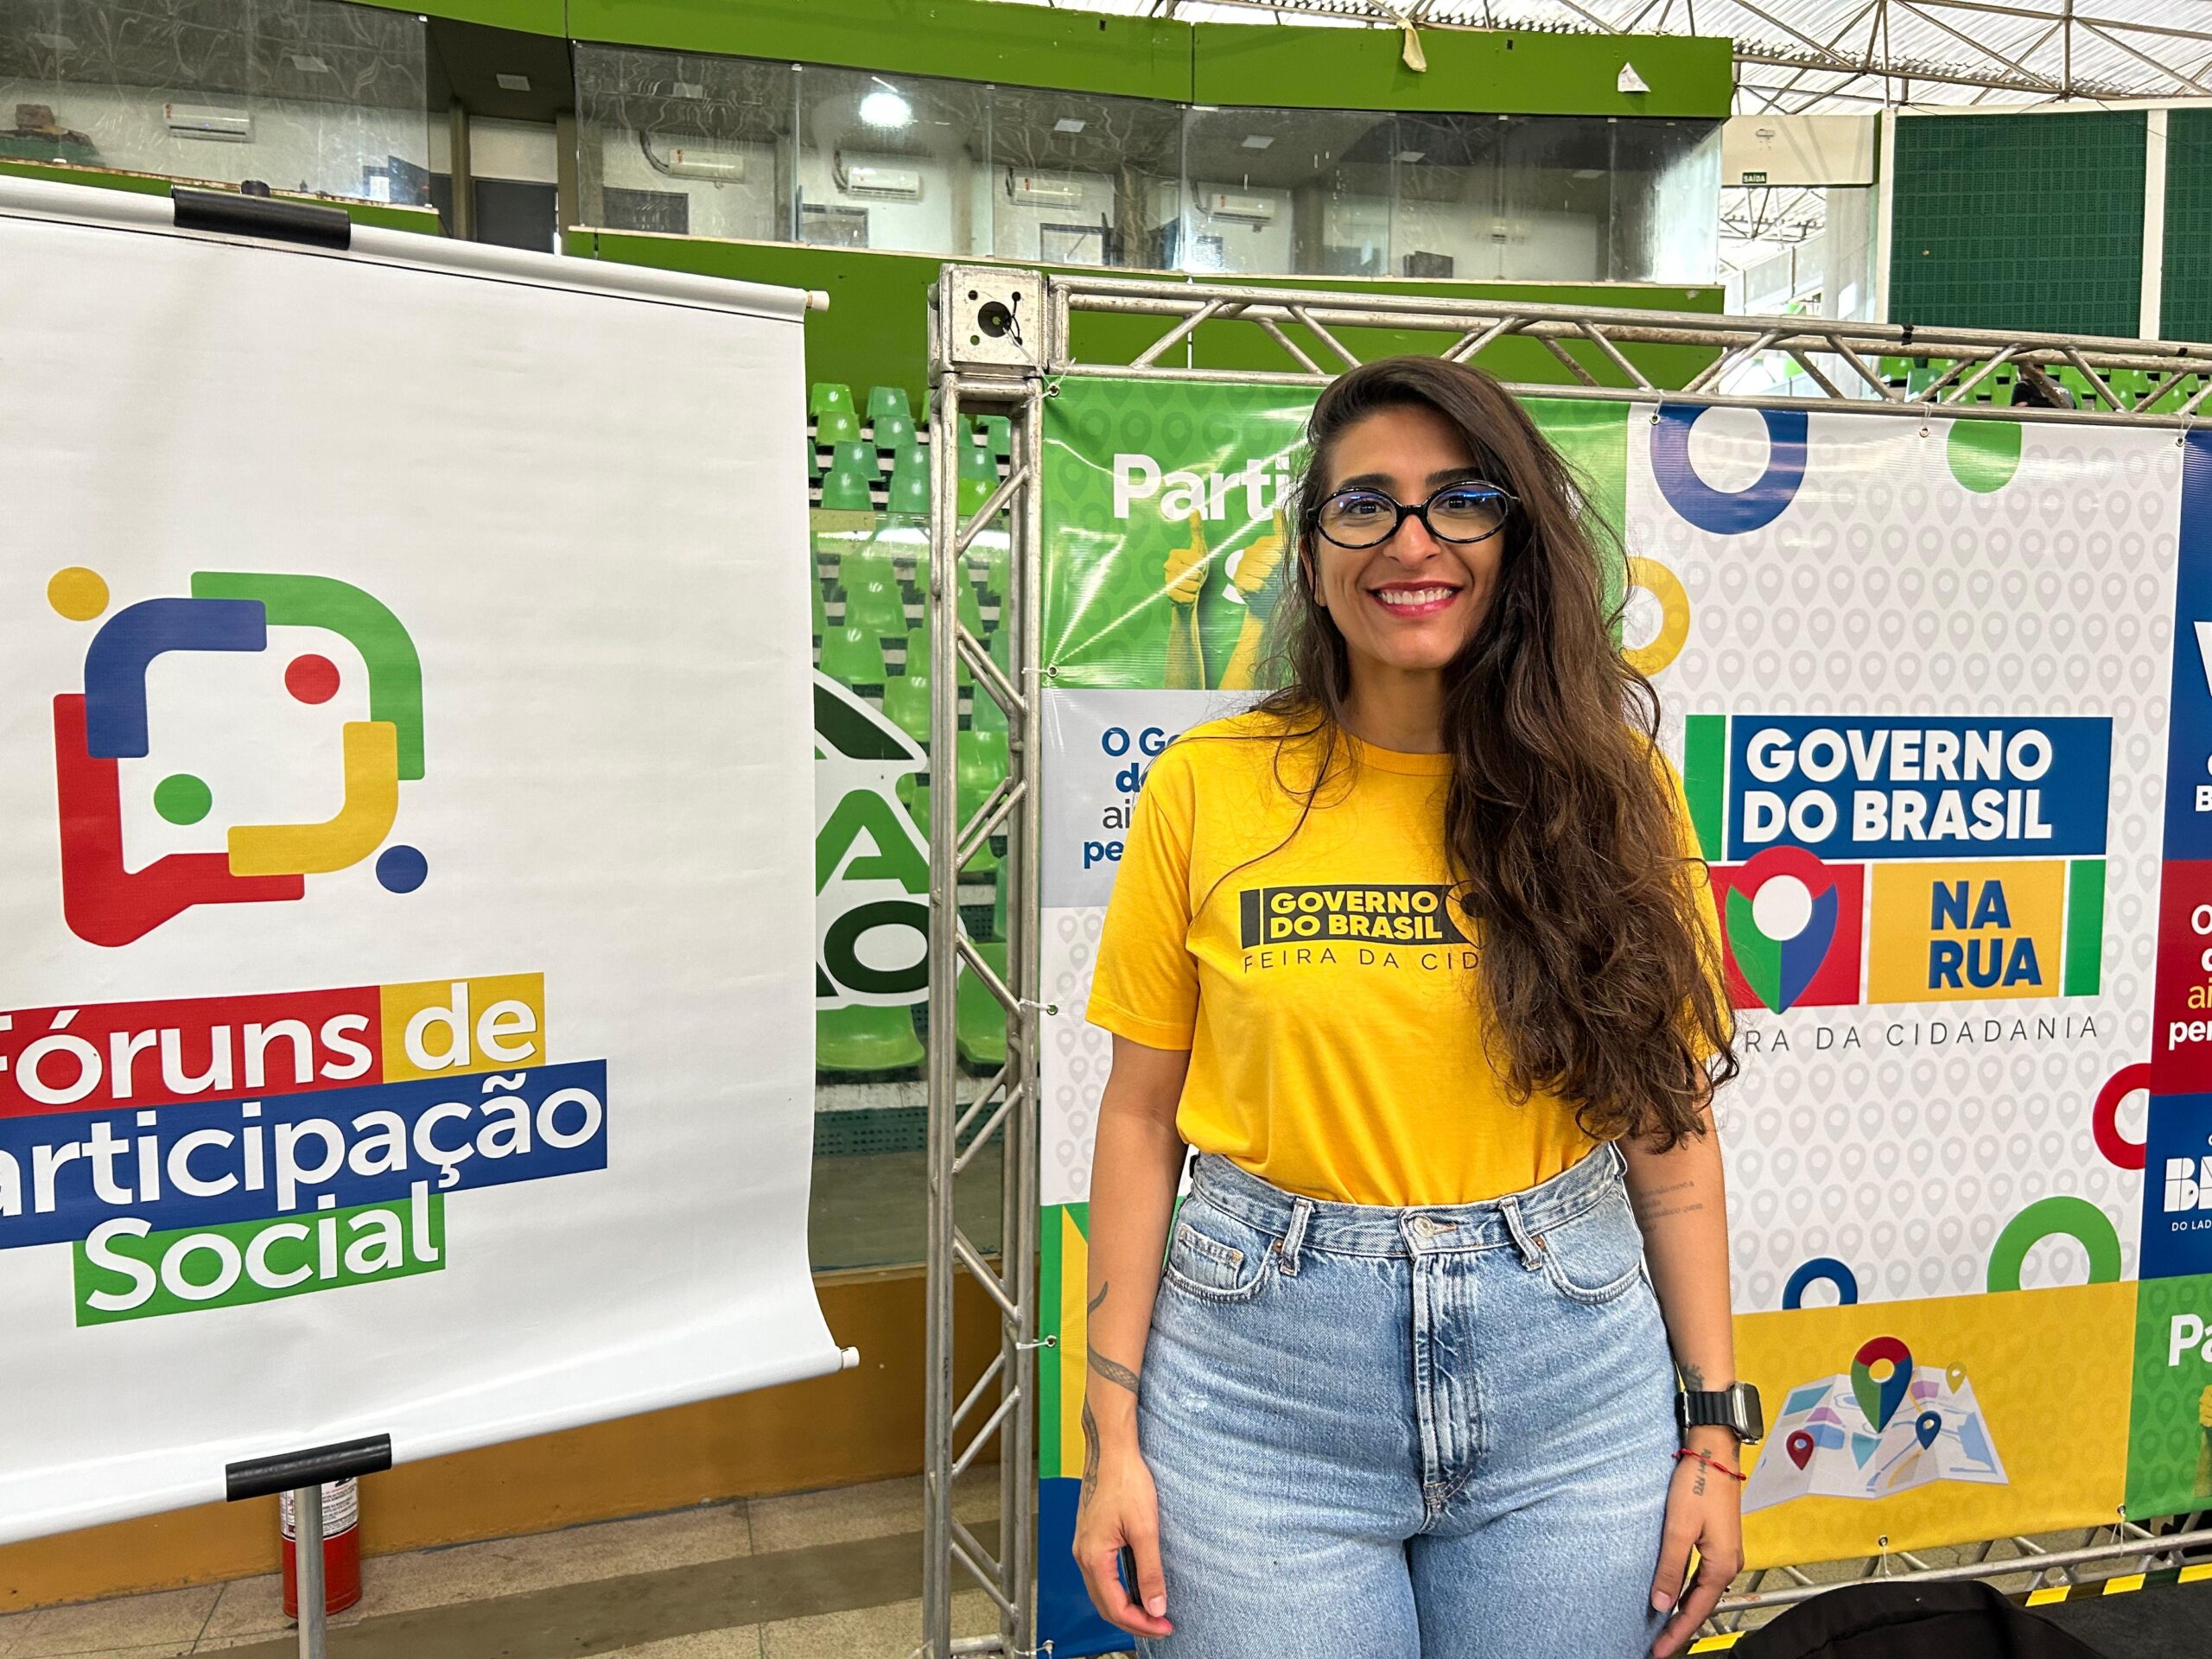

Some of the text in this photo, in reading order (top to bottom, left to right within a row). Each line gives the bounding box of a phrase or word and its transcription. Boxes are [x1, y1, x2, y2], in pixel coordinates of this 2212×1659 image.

[1744, 174, 1765, 182] SAÍDA
[1102, 727, 1130, 757] O
[1745, 728, 2053, 784] GOVERNO
[1116, 762, 1148, 792] d
[1743, 788, 2052, 844] DO BRASIL
[1270, 891, 1439, 914] GOVERNO
[1930, 880, 2012, 931] NA
[1270, 914, 1443, 939] DO BRASIL
[1244, 948, 1478, 974] FEIRA DA CID
[1928, 938, 2043, 989] RUA
[404, 982, 537, 1071] de
[1816, 1027, 1861, 1051] DA
[1886, 1015, 2098, 1047] CIDADANIA
[2171, 1221, 2188, 1231] DO
[86, 1180, 439, 1313] Social
